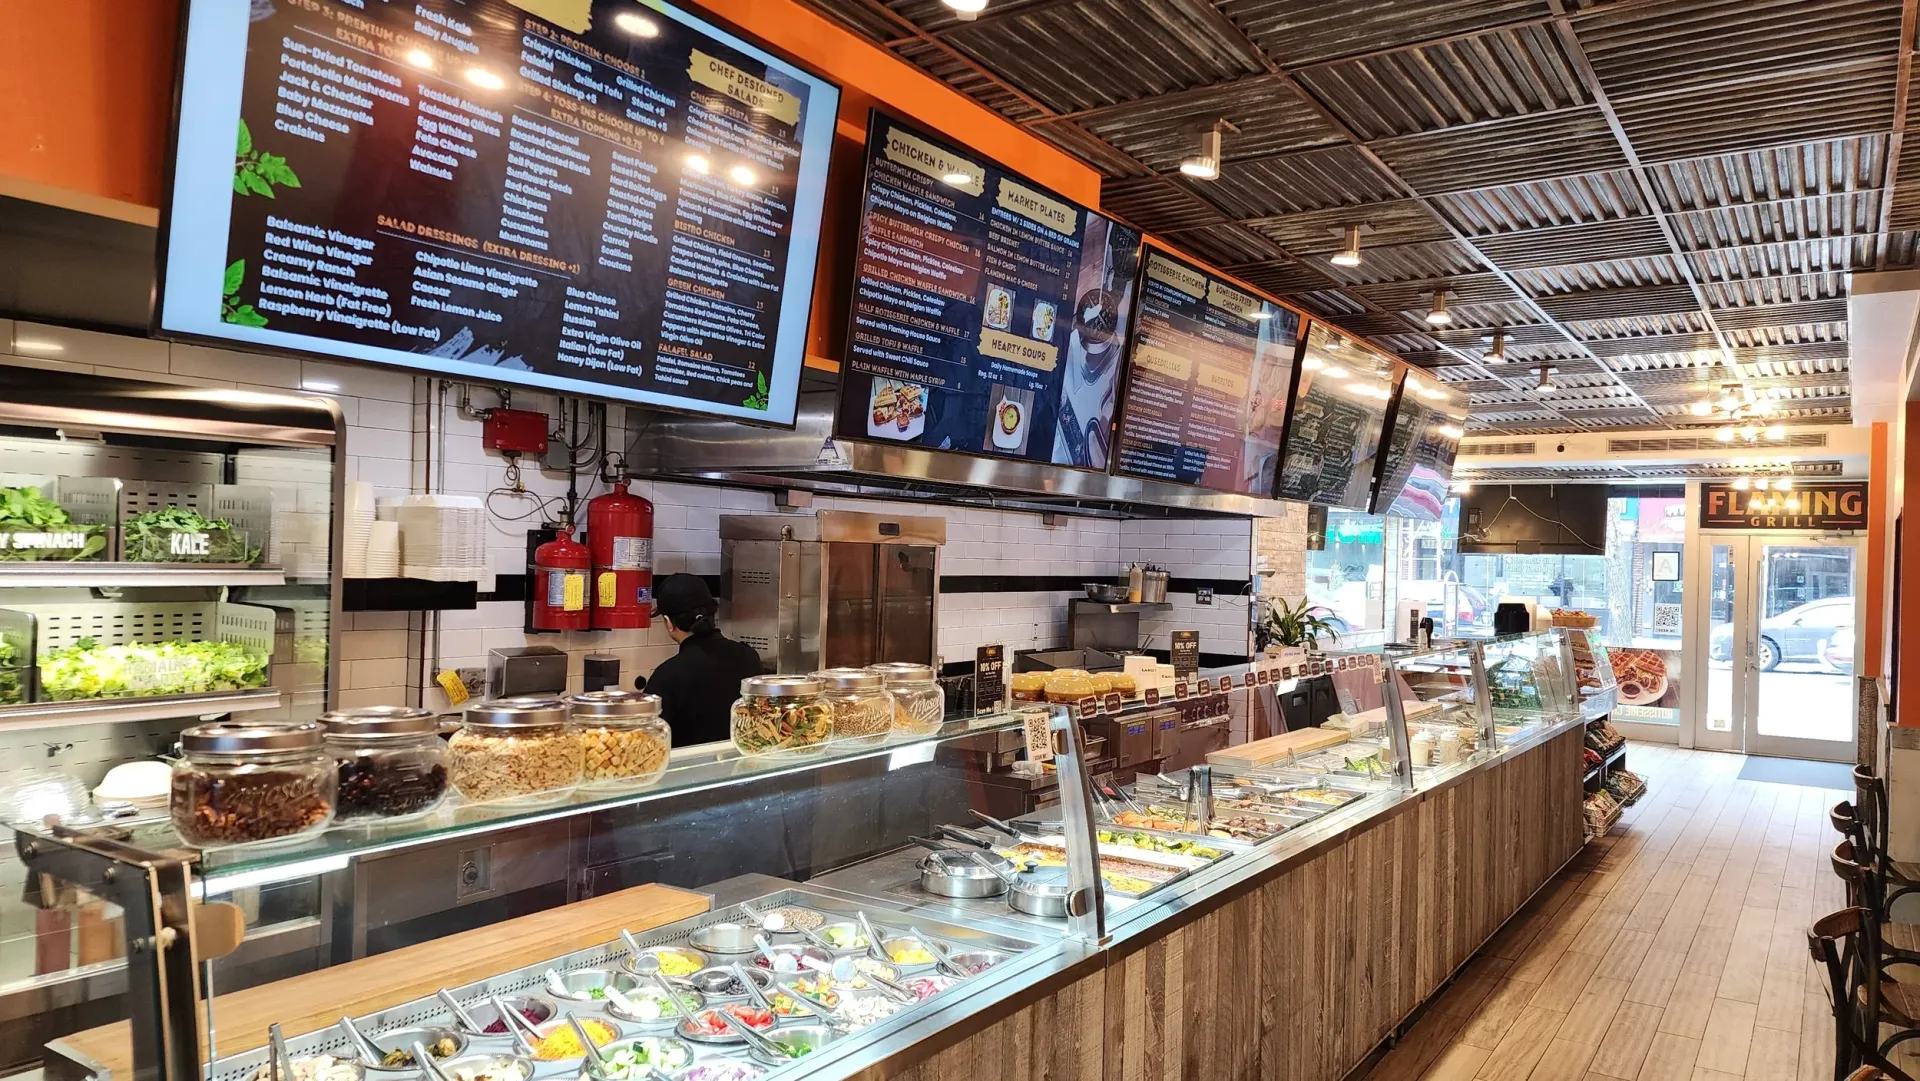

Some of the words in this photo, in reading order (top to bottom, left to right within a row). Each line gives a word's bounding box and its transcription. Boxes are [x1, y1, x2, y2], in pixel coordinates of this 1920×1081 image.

[415, 4, 446, 27] Fresh
[446, 16, 472, 36] Kale
[414, 21, 440, 40] Baby
[441, 32, 480, 54] Arugula
[282, 37, 345, 66] Sun-Dried
[346, 58, 402, 88] Tomatoes
[520, 52, 554, 72] Falafel
[522, 36, 554, 59] Crispy
[554, 49, 592, 72] Chicken
[280, 54, 342, 83] Portobello
[343, 75, 410, 106] Mushrooms
[574, 73, 602, 92] Grilled
[603, 86, 622, 100] Tofu
[616, 76, 644, 96] Grilled
[644, 86, 676, 107] Chicken
[709, 62, 734, 84] CHEF
[737, 74, 784, 104] DESIGNED
[278, 86, 310, 107] Baby
[311, 96, 374, 126] Mozzarella
[727, 84, 764, 108] SALADS
[274, 119, 325, 142] Craisins
[276, 103, 304, 120] Blue
[304, 112, 350, 134] Cheese
[412, 145, 458, 167] Avocado
[892, 139, 936, 168] CHICKEN
[938, 160, 944, 170] &
[410, 159, 453, 180] Walnuts
[502, 205, 544, 224] Tomatoes
[504, 192, 548, 212] Chickpeas
[1008, 190, 1038, 211] MARKET
[1040, 205, 1065, 223] PLATES
[266, 215, 326, 240] Balsamic
[327, 230, 376, 251] Vinegar
[498, 230, 548, 251] Mushrooms
[500, 218, 549, 238] Cucumbers
[674, 220, 702, 238] BISTRO
[703, 228, 736, 246] CHICKEN
[764, 248, 772, 258] 13
[264, 232, 290, 248] Red
[292, 238, 324, 256] Wine
[325, 246, 373, 267] Vinegar
[377, 214, 414, 234] SALAD
[416, 224, 478, 250] DRESSINGS
[484, 240, 518, 260] (EXTRA
[520, 251, 566, 271] DRESSING
[600, 245, 633, 262] Scallions
[602, 234, 630, 248] Carrots
[263, 249, 315, 272] Creamy
[316, 260, 356, 278] Ranch
[415, 252, 460, 271] Chipotle
[460, 261, 484, 276] Lime
[485, 268, 538, 288] Vinaigrette
[986, 256, 996, 265] FISH
[1002, 261, 1017, 272] CHIPS
[262, 265, 322, 288] Balsamic
[322, 276, 388, 300] Vinaigrette
[412, 280, 451, 298] Caesar
[413, 266, 444, 282] Asian
[445, 272, 485, 292] Sesame
[486, 280, 518, 298] Ginger
[667, 278, 694, 293] GREEK
[694, 284, 725, 300] CHICKEN
[756, 300, 764, 309] 13
[863, 263, 888, 277] GRILLED
[889, 272, 915, 285] CHICKEN
[917, 280, 937, 292] WAFFLE
[938, 287, 967, 300] SANDWICH
[1182, 274, 1204, 290] CHICKEN
[260, 282, 303, 300] Lemon
[304, 290, 335, 306] Herb
[336, 294, 361, 310] (Fat
[361, 300, 392, 318] Free)
[566, 286, 585, 300] Blue
[586, 291, 616, 306] Cheese
[1216, 285, 1239, 302] BONELESS
[1239, 296, 1252, 307] FRIED
[1222, 300, 1243, 313] CHICKEN
[258, 298, 324, 322] Raspberry
[325, 310, 390, 330] Vinaigrette
[391, 321, 418, 336] (Low
[418, 326, 441, 342] Fat)
[410, 296, 440, 311] Fresh
[441, 302, 475, 317] Lemon
[476, 308, 502, 322] Juice
[563, 313, 596, 328] Russian
[564, 300, 592, 315] Lemon
[593, 306, 620, 320] Tahini
[859, 302, 874, 313] HALF
[875, 307, 909, 322] ROTISSERIE
[910, 317, 935, 329] CHICKEN
[936, 322, 939, 330] &
[941, 324, 960, 336] WAFFLE
[562, 326, 585, 341] Extra
[586, 332, 610, 347] Virgin
[610, 336, 630, 350] Olive
[631, 339, 642, 350] Oil
[856, 316, 875, 328] Served
[875, 322, 888, 331] with
[888, 325, 909, 337] Flaming
[910, 331, 925, 339] House
[926, 334, 941, 344] Sauce
[560, 339, 586, 354] Italian
[587, 344, 606, 358] (Low
[606, 348, 624, 361] Fat)
[855, 332, 881, 344] GRILLED
[882, 338, 897, 346] TOFU
[902, 342, 923, 354] WAFFLE
[991, 339, 1021, 355] HEARTY
[1022, 347, 1046, 361] SOUPS
[558, 352, 584, 368] Honey
[585, 358, 606, 372] Dijon
[607, 360, 626, 374] (Low
[626, 363, 642, 377] Fat)
[658, 344, 688, 358] FALAFEL
[690, 351, 713, 361] SALAD
[748, 360, 756, 369] 12
[852, 360, 871, 371] PLAIN
[871, 365, 894, 376] WAFFLE
[895, 370, 909, 378] WITH
[910, 373, 927, 382] MAPLE
[928, 376, 945, 386] SYRUP
[1708, 491, 1862, 516] FLAMING
[1750, 517, 1816, 527] GRILL
[13, 532, 85, 549] SPINACH
[170, 533, 210, 555] KALE
[1658, 557, 1673, 573] A
[1185, 641, 1197, 649] OFF
[980, 662, 990, 672] 10%
[990, 661, 1002, 670] OFF
